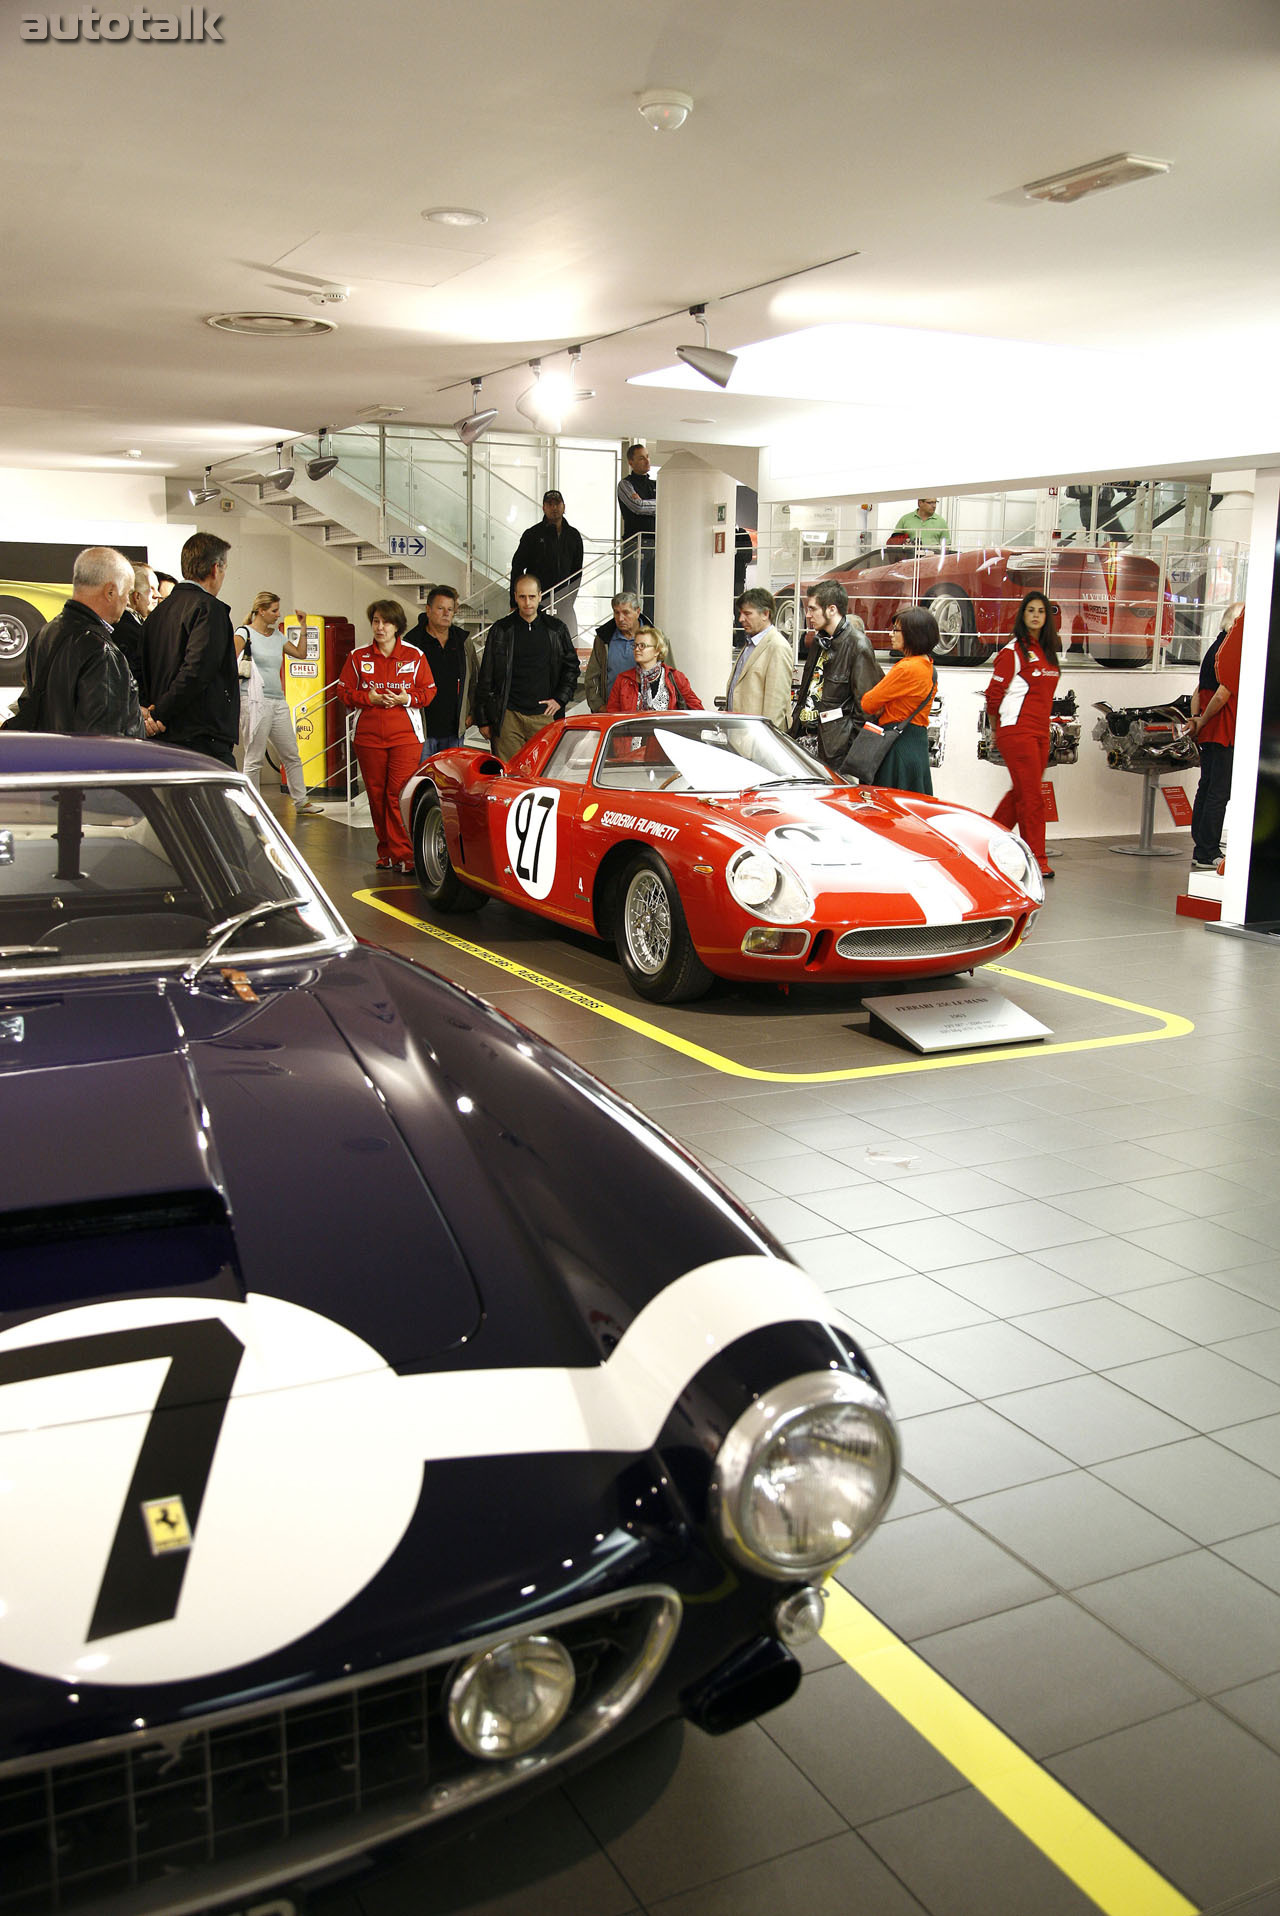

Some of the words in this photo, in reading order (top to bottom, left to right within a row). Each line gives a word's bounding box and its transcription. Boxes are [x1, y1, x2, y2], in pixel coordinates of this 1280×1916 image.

[1082, 594, 1117, 602] MYTHOS
[515, 792, 555, 884] 97
[601, 810, 637, 830] SCUDERIA
[633, 817, 680, 841] FILIPINETTI
